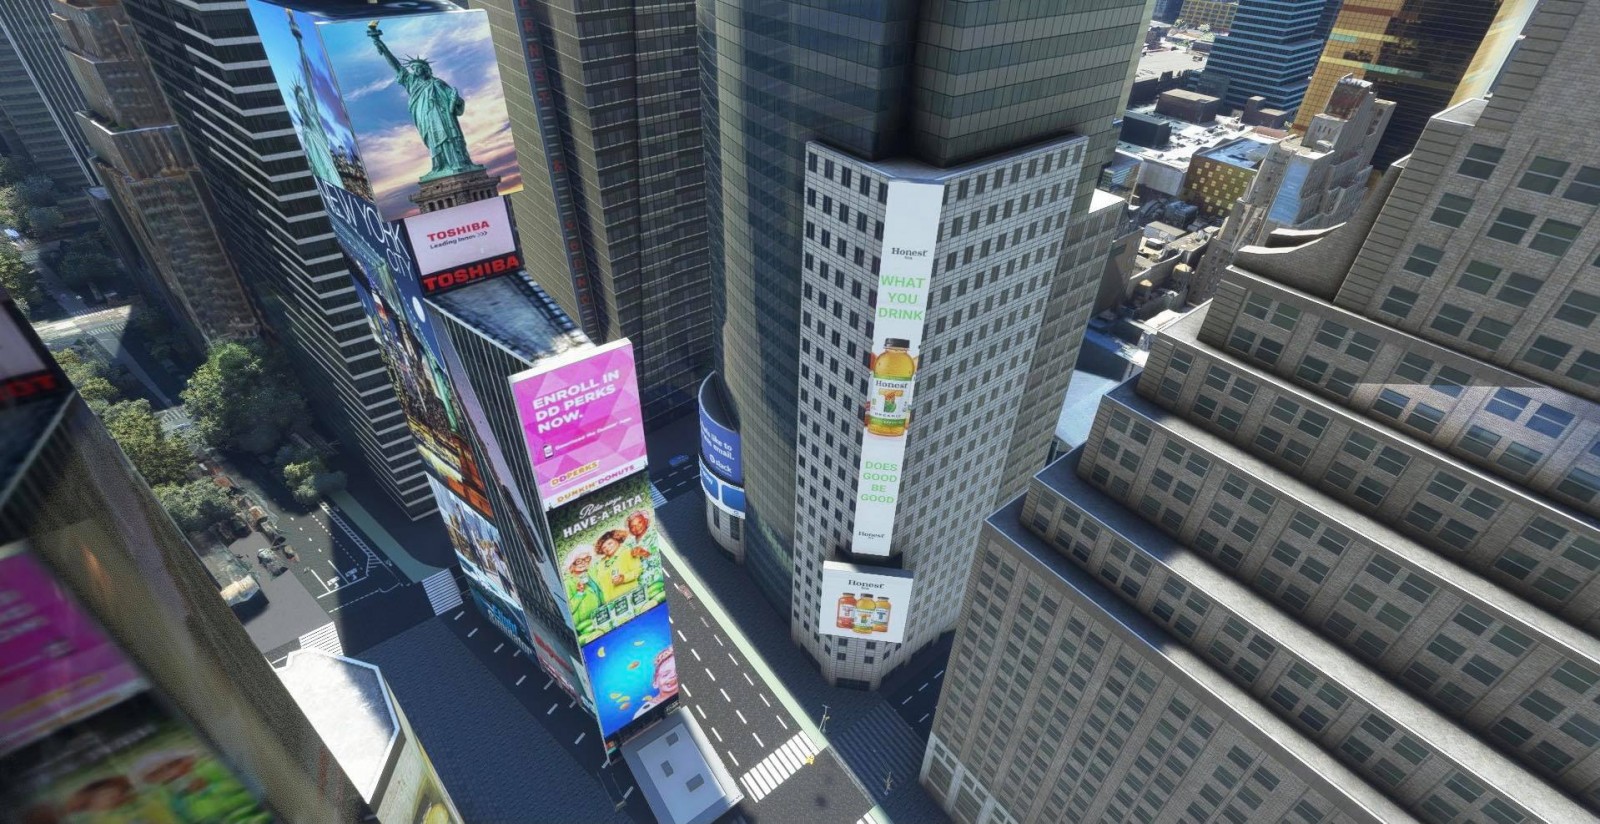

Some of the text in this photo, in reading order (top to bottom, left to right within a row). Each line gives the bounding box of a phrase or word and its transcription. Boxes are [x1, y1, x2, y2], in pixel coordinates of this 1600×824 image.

[313, 175, 411, 260] NEW YORK
[427, 220, 490, 242] TOSHIBA
[430, 238, 458, 249] Leading
[891, 247, 928, 257] Honest
[386, 248, 413, 281] CITY
[423, 255, 519, 292] TOSHIBA
[879, 275, 926, 288] WHAT
[888, 292, 918, 305] YOU
[878, 307, 924, 321] DRINK
[533, 369, 621, 410] ENROLL IN
[876, 380, 908, 389] Honest
[535, 384, 616, 422] DD PERKS
[537, 409, 583, 434] NOW.
[713, 444, 735, 461] email.
[723, 442, 733, 452] to
[865, 461, 898, 472] DOES
[598, 464, 635, 485] DONUTS
[862, 472, 898, 483] GOOD
[871, 483, 886, 493] BE
[860, 493, 895, 504] GOOD
[848, 579, 885, 589] Honest
